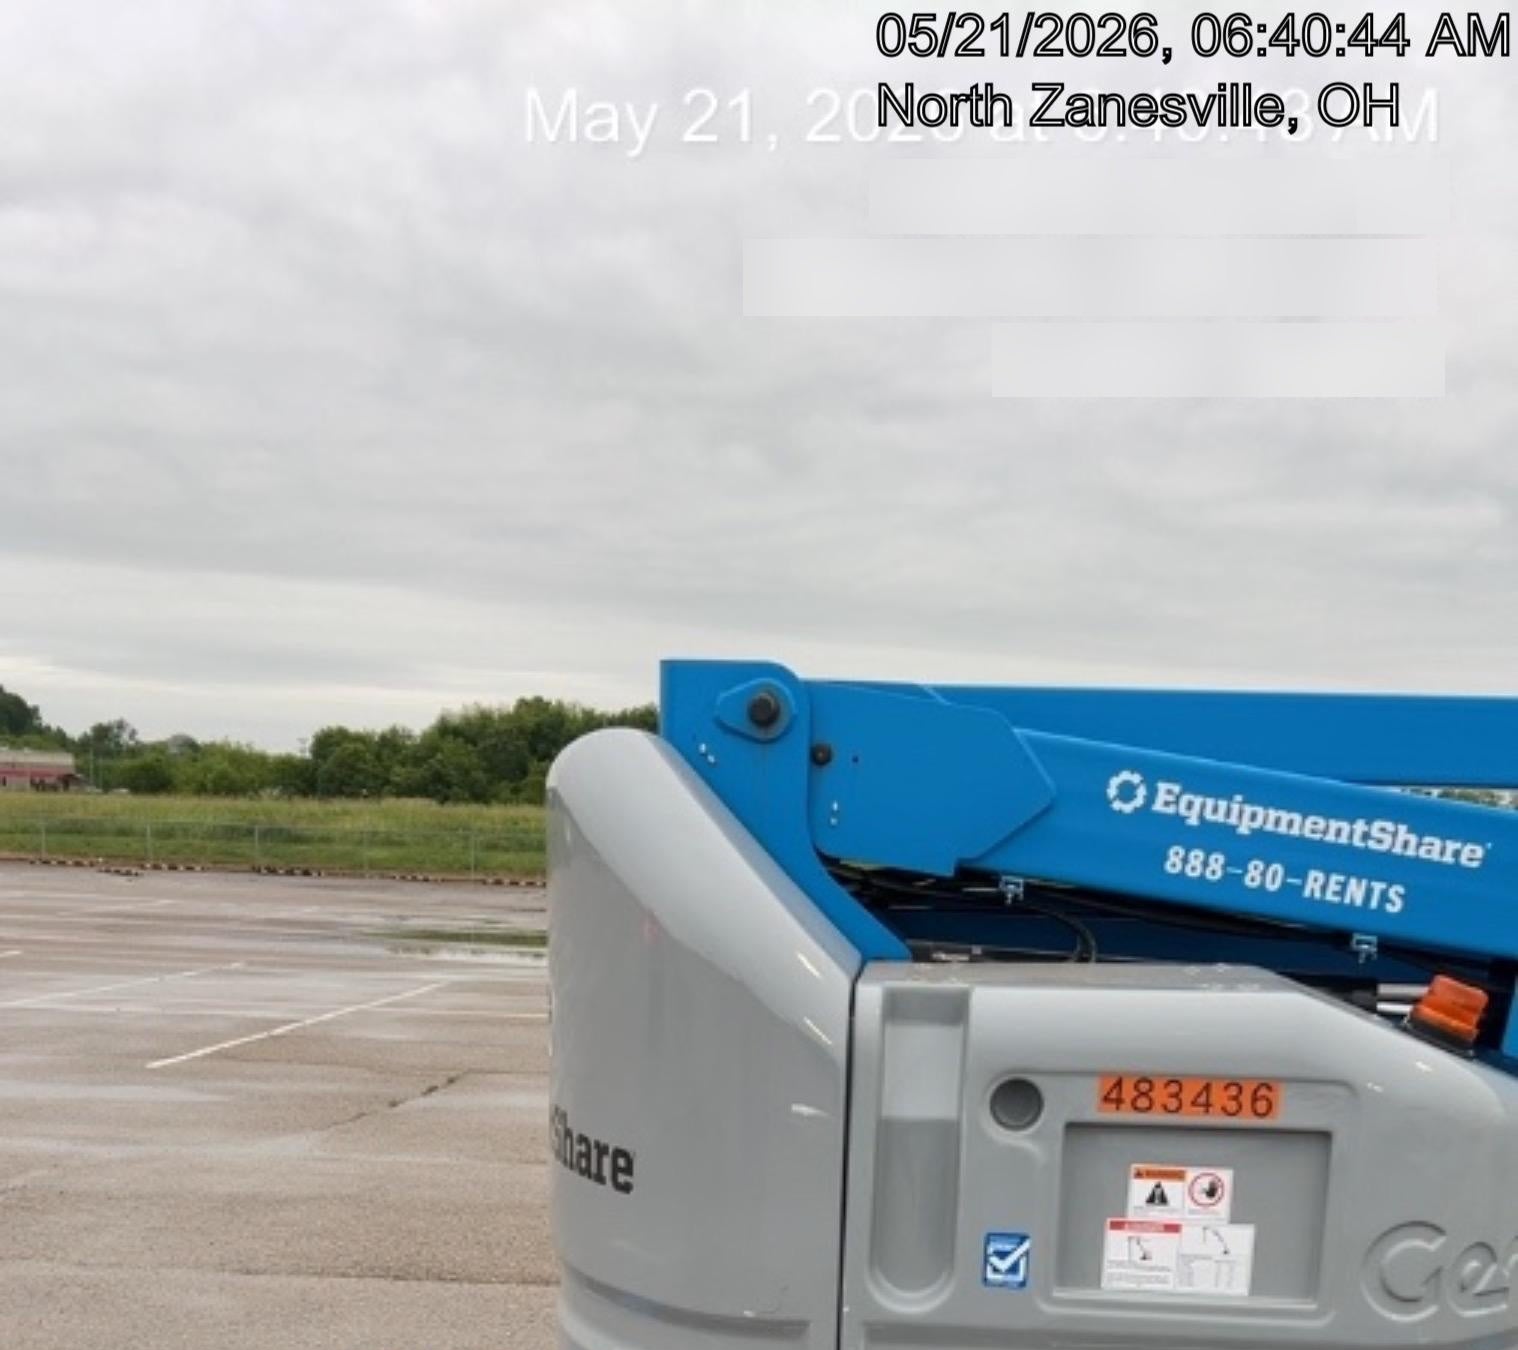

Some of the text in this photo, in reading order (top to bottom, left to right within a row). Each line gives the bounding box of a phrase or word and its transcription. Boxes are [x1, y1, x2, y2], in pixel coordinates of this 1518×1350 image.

[1151, 781, 1486, 869] EquipmentShare
[1164, 845, 1406, 914] 888-80-RENTS
[1102, 1077, 1273, 1118] 483436
